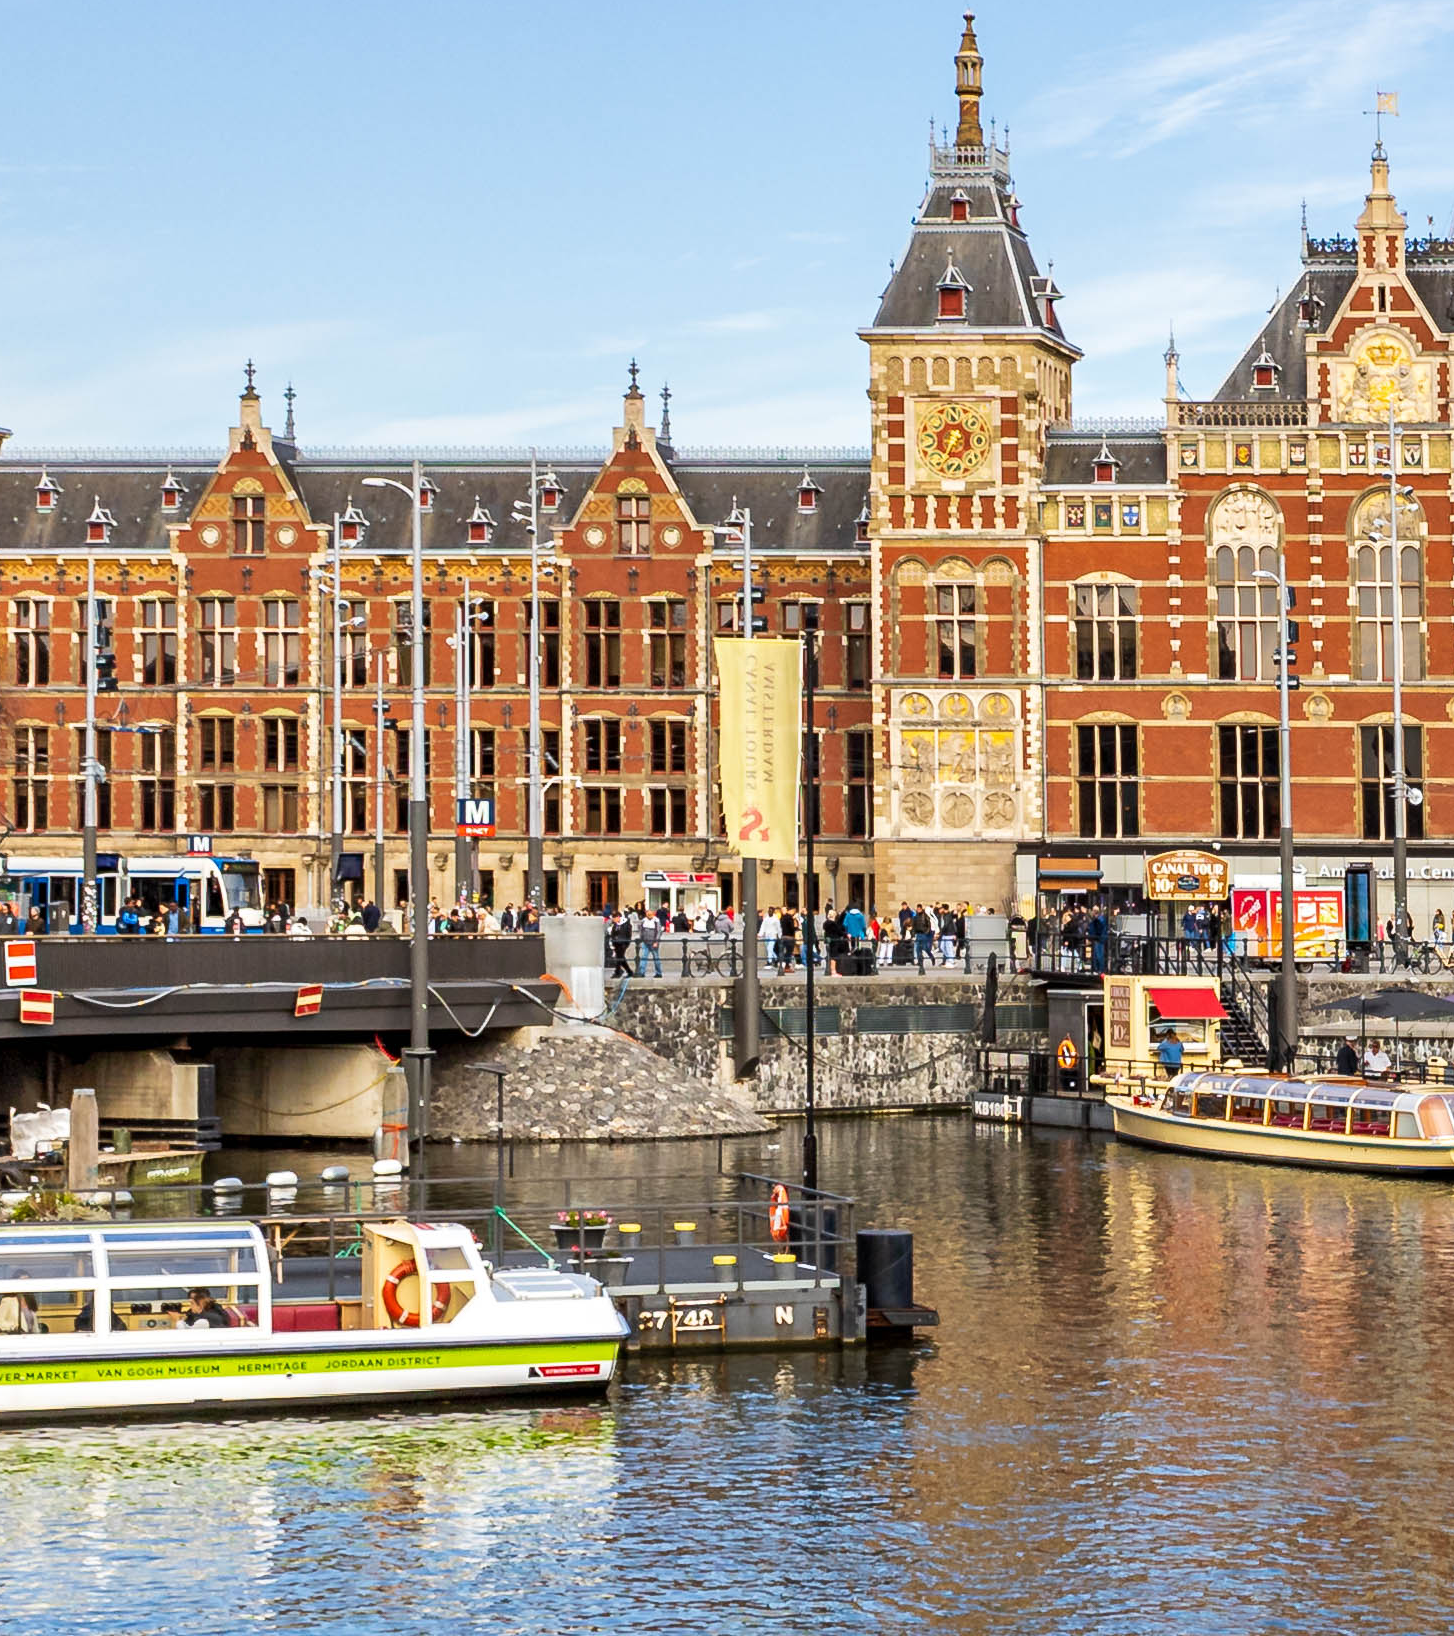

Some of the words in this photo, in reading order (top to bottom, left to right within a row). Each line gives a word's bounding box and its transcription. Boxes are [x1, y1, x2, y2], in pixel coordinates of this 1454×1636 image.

[465, 800, 490, 824] M
[193, 836, 210, 852] M
[1152, 862, 1191, 875] CANAL
[1192, 863, 1224, 876] TOUR
[774, 1305, 794, 1325] N
[23, 1370, 78, 1381] MARKET
[97, 1368, 123, 1378] VAN
[127, 1367, 164, 1377] GOGH
[168, 1365, 220, 1375] MUSEUM
[237, 1361, 307, 1373] HERMITAGE
[325, 1358, 383, 1369] JORDAAN
[387, 1356, 442, 1367] DISTRICT
